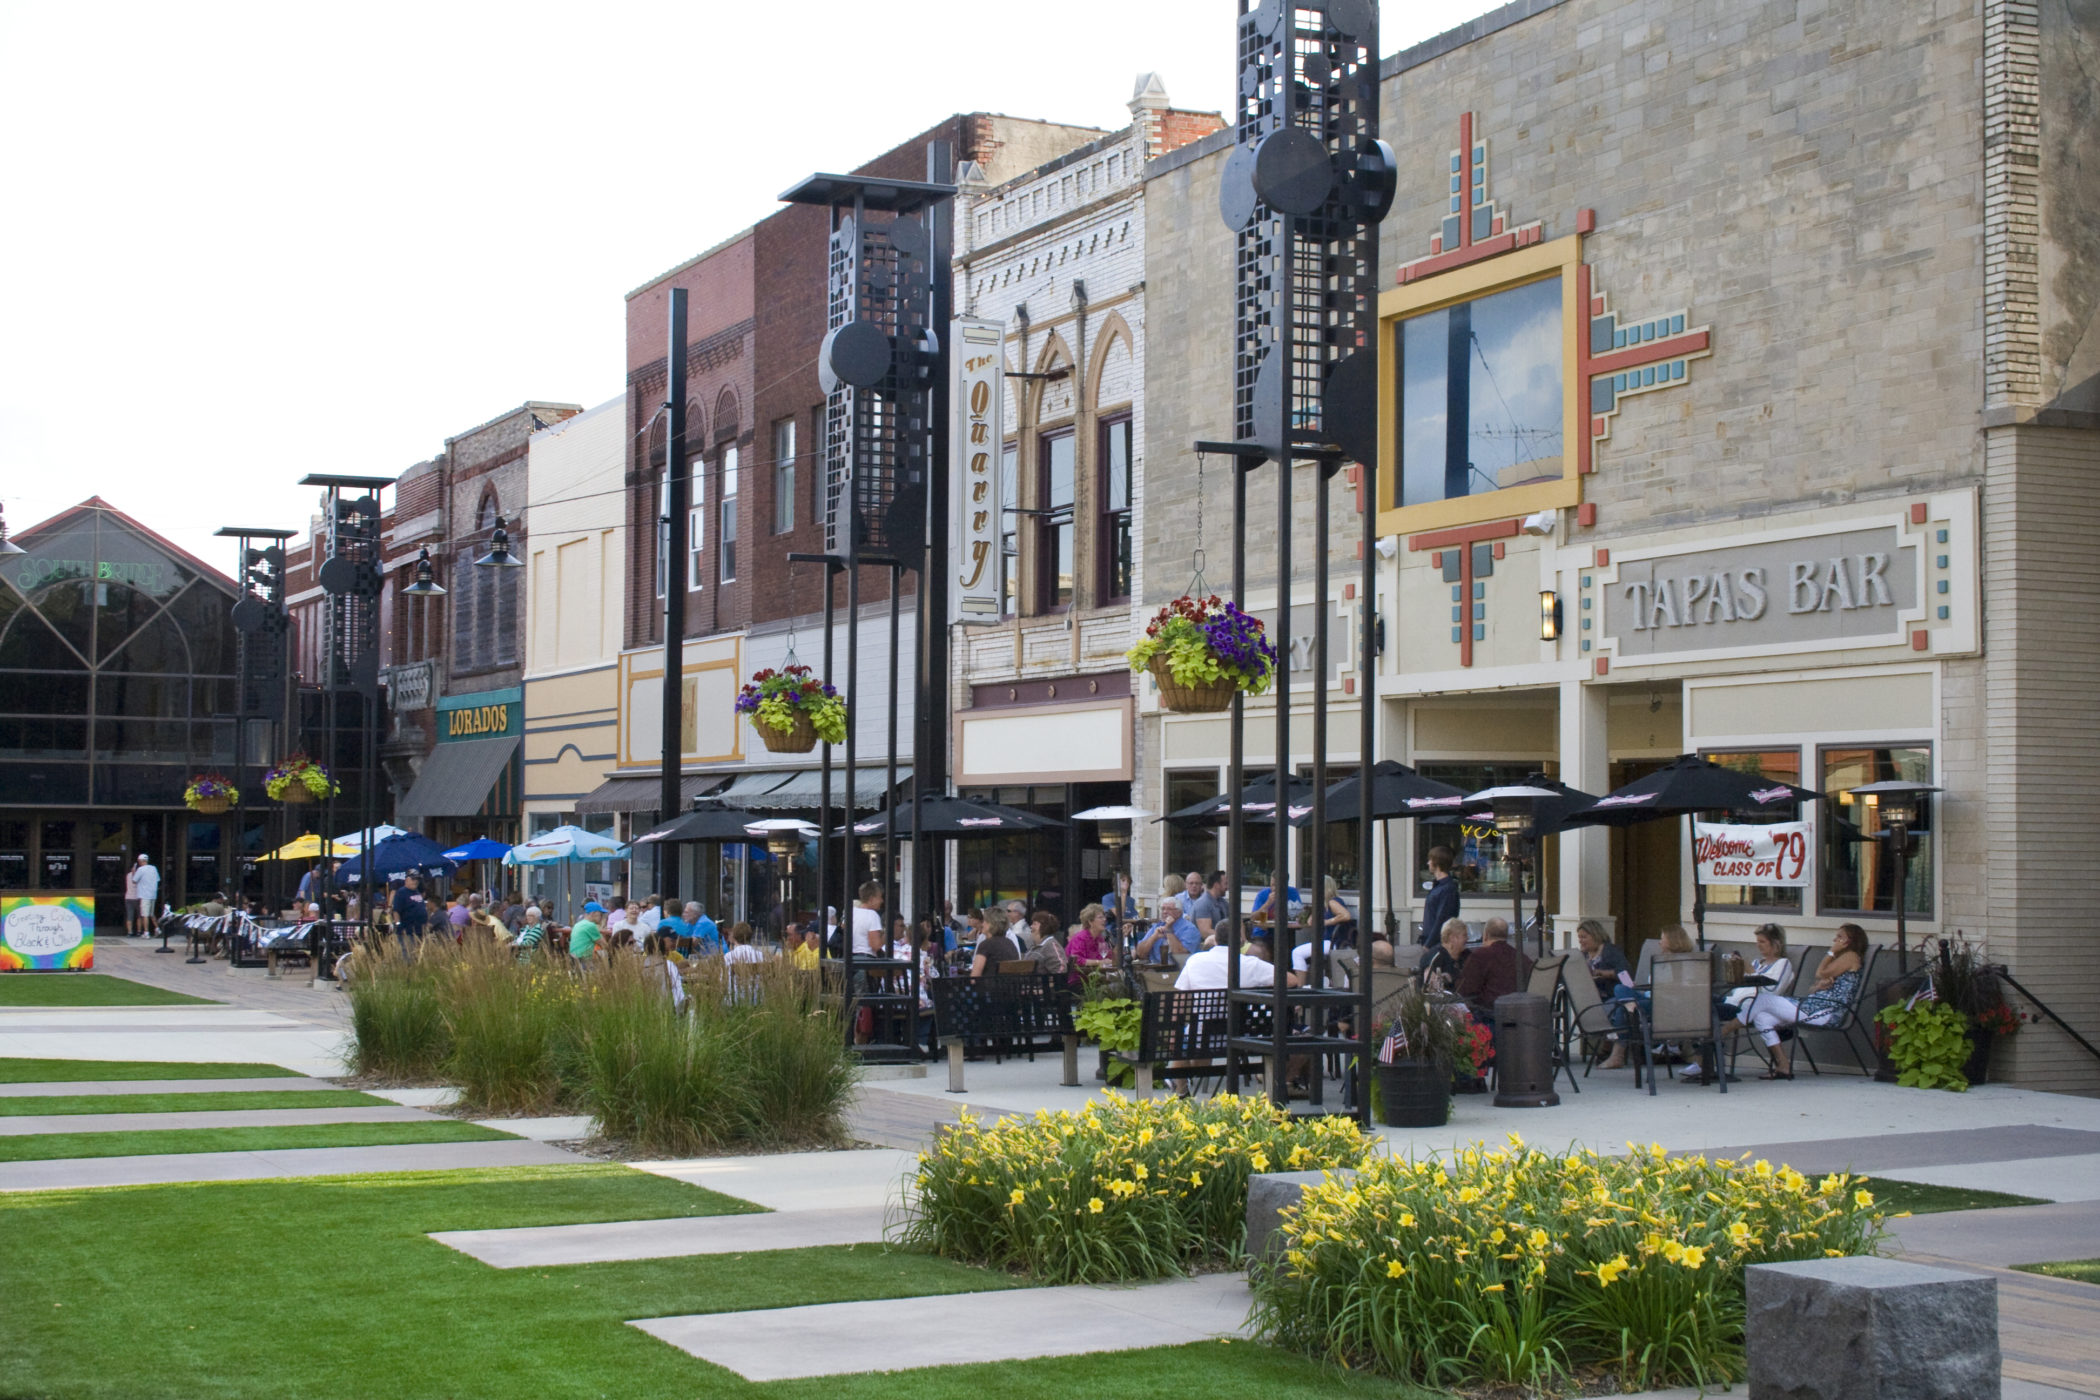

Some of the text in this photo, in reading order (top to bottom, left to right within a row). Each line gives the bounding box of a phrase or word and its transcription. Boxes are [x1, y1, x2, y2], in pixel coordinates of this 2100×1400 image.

[964, 353, 995, 374] The
[959, 380, 993, 589] Quarry
[17, 557, 165, 593] SOUTHBRIDGE
[1624, 552, 1895, 631] TAPAS BAR
[448, 704, 508, 736] LORADOS
[1695, 832, 1756, 864] Welcome
[1713, 861, 1753, 877] CLASS
[1755, 861, 1776, 877] OF
